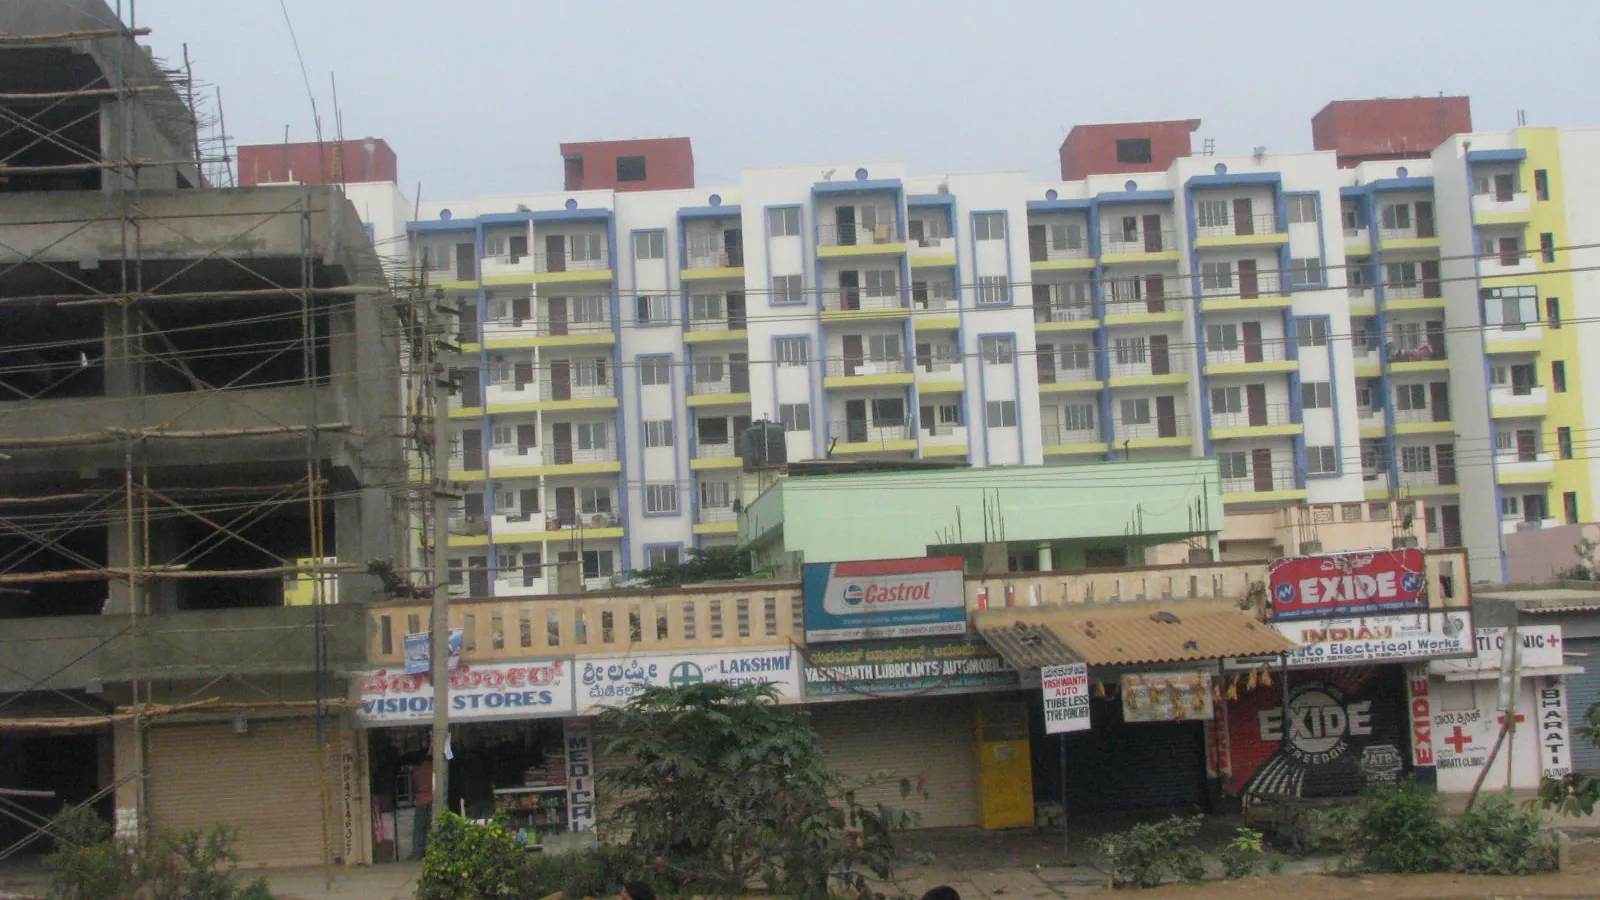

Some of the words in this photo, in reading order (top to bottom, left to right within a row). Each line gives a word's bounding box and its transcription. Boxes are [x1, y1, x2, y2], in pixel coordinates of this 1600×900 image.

[865, 581, 930, 603] Castrol
[1299, 571, 1398, 604] EXIDE
[1301, 626, 1392, 643] INDIAN
[1496, 634, 1544, 651] CNIC
[1330, 641, 1411, 654] Electrical
[1418, 638, 1460, 649] Works
[720, 655, 790, 673] LAKSHMI
[875, 660, 940, 679] LUBRICANTS
[453, 690, 553, 710] STORES
[1056, 687, 1078, 697] AUTO
[1257, 700, 1373, 743] EXIDE
[1409, 680, 1433, 764] EXIDE
[1541, 689, 1563, 764] BHARATI
